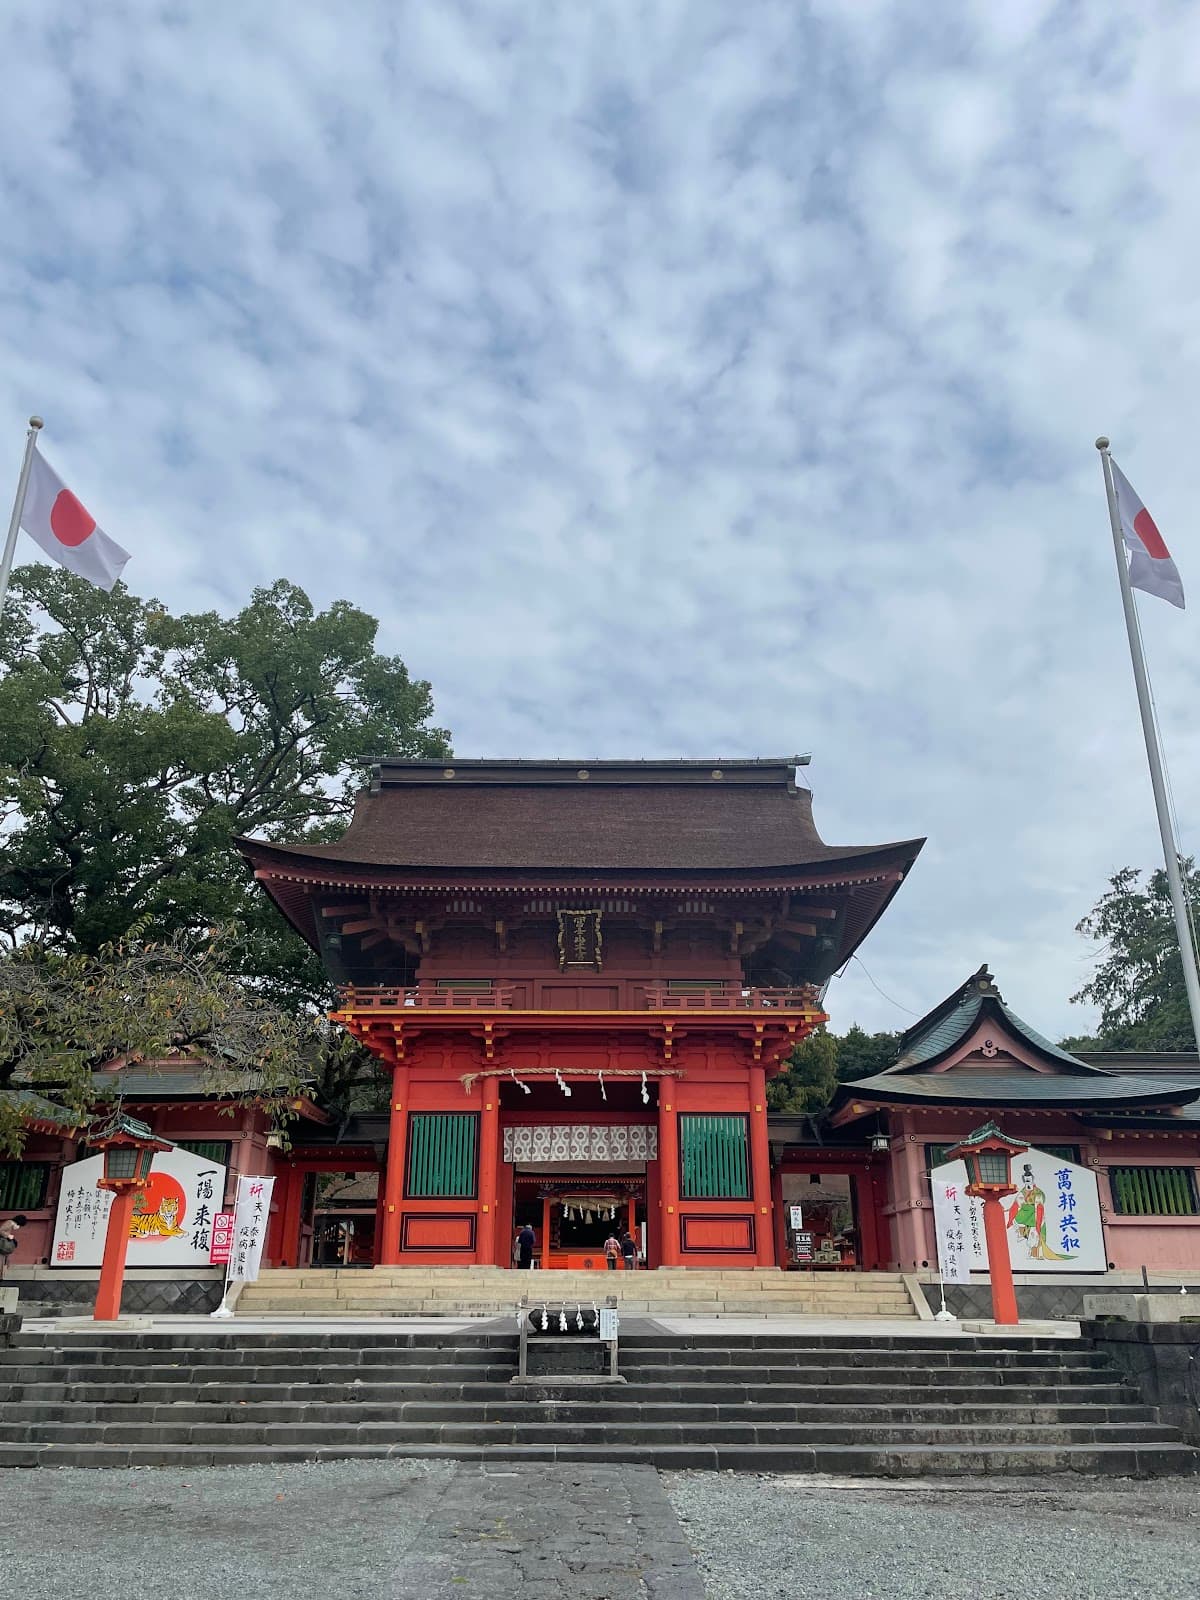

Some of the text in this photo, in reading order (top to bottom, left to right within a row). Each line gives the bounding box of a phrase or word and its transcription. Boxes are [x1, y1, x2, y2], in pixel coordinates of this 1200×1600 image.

[190, 1170, 218, 1252] 一陽来復
[249, 1183, 264, 1198] 祈
[945, 1186, 957, 1201] 祈
[1054, 1167, 1081, 1252] 萬邦共和
[248, 1202, 263, 1249] 天下泰平
[953, 1205, 965, 1252] 天下泰平
[237, 1226, 249, 1276] 疫病退散
[946, 1228, 958, 1278] 疫病退散
